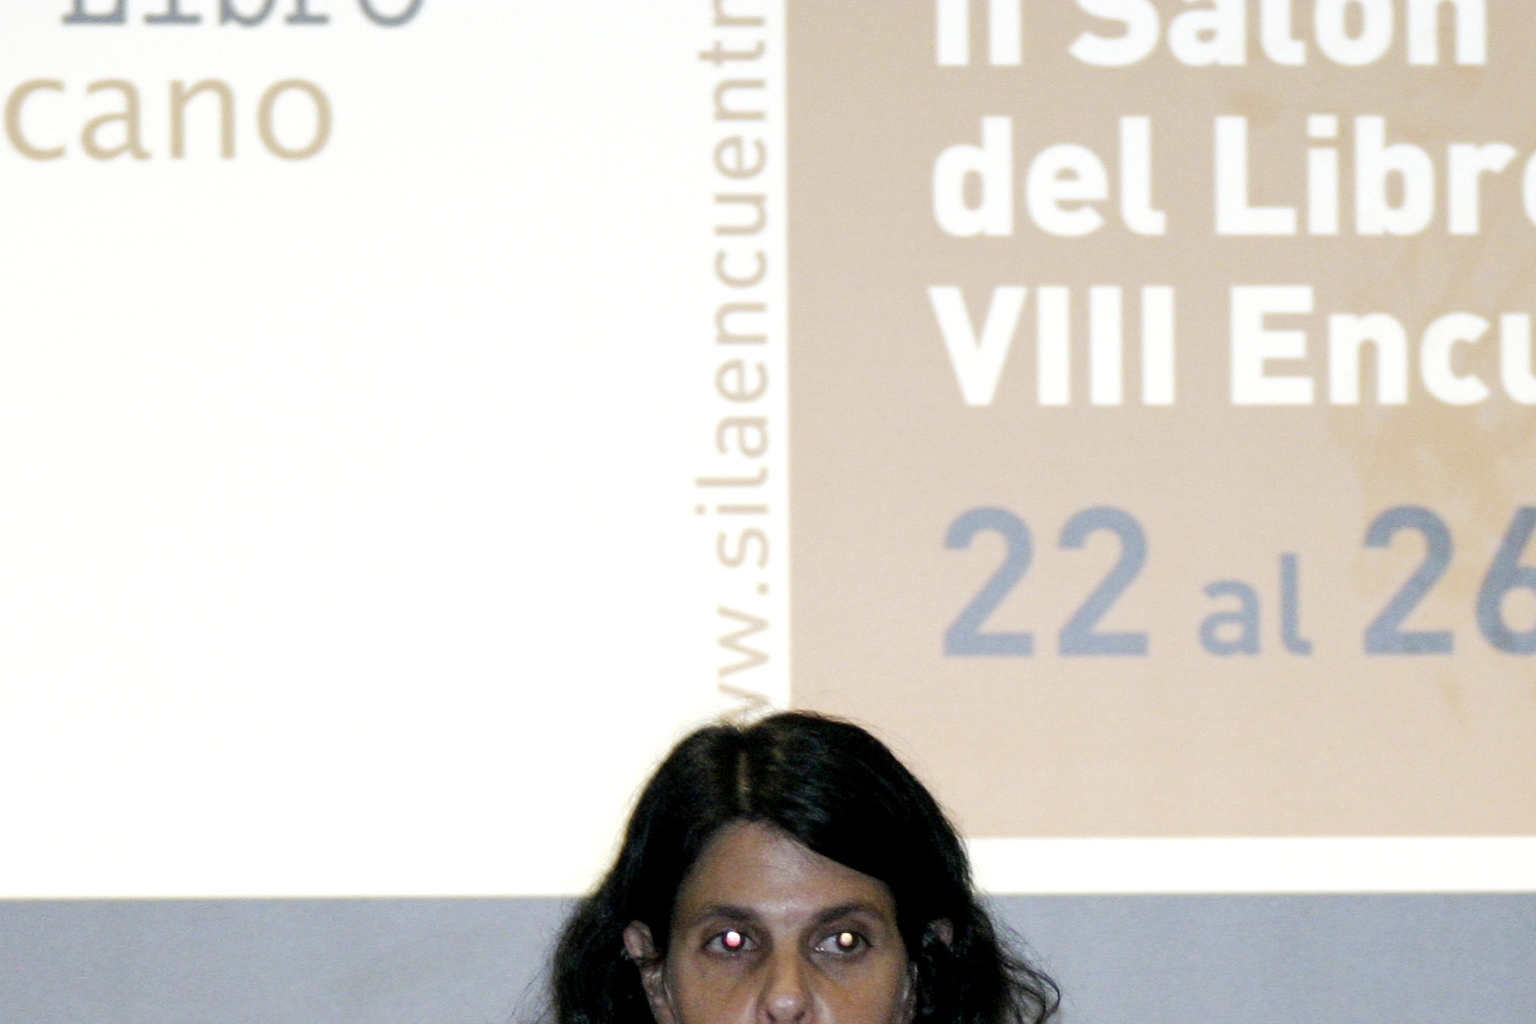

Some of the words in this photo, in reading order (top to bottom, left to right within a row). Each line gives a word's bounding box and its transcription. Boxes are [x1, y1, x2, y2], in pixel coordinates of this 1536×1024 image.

[3, 77, 333, 162] cano
[932, 115, 1166, 236] del
[927, 285, 1175, 407] VIII
[943, 506, 1149, 658] 22
[1199, 552, 1314, 657] al
